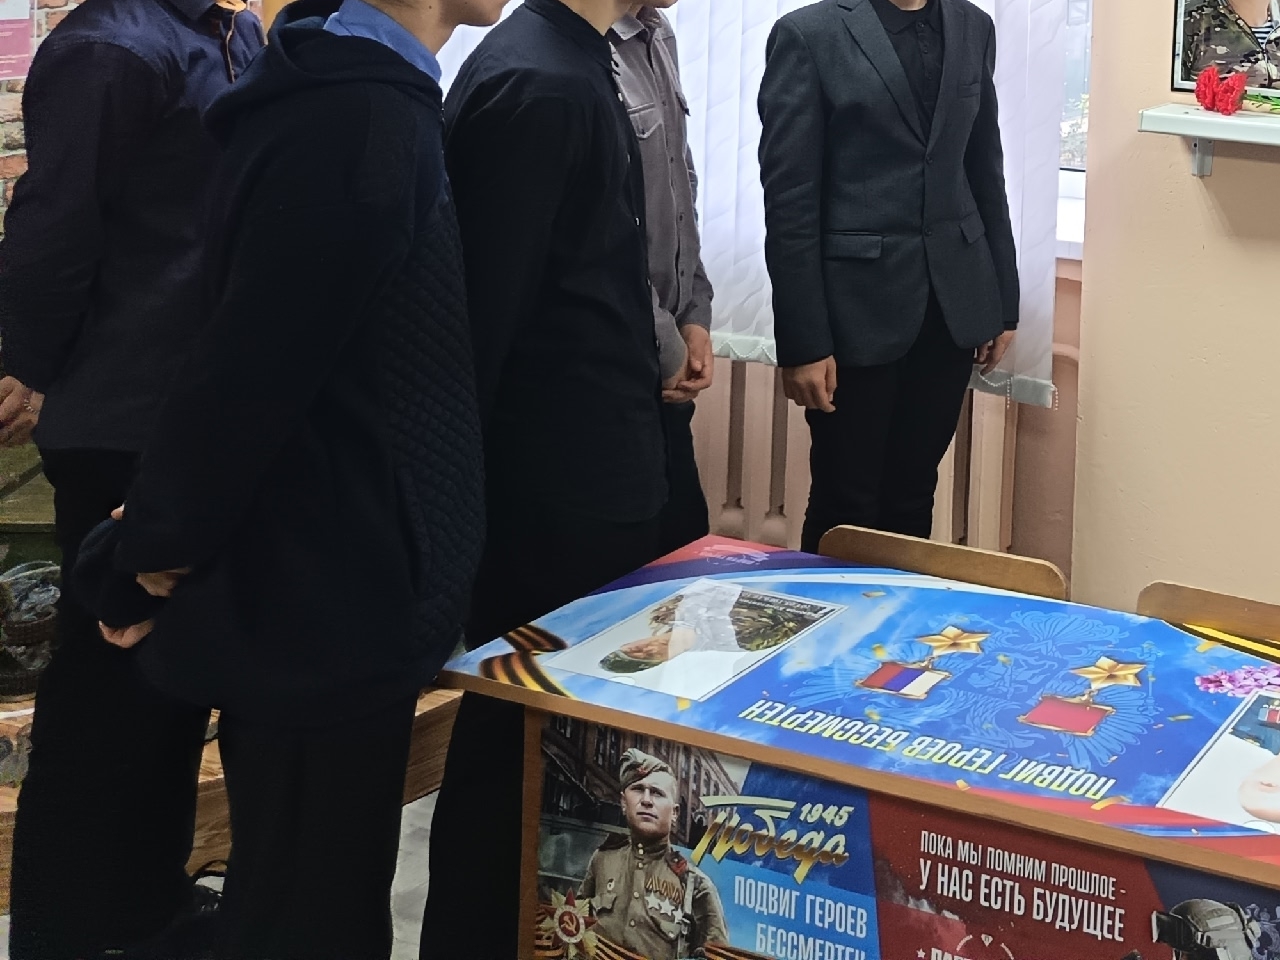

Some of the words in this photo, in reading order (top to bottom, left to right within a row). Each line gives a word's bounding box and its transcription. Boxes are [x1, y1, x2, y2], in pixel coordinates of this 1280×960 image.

[737, 699, 909, 752] БЕССМЕРТЕН
[906, 735, 1001, 776] ГЕРОЕВ
[1000, 754, 1117, 800] ПОДВИГ
[690, 795, 850, 885] Победа
[799, 802, 854, 826] 1945
[920, 829, 953, 861] ПОКА
[956, 837, 982, 867] МЫ
[986, 844, 1046, 883] ПОМНИМ
[1050, 860, 1116, 901] ПРОШЛОЕ
[733, 875, 800, 921] ПОДВИГ
[805, 893, 868, 939] ГЕРОЕВ
[919, 858, 933, 892] У
[936, 863, 973, 903] НАС
[980, 873, 1026, 914] ЕСТЬ
[1032, 888, 1126, 942] БУДУЩЕЕ
